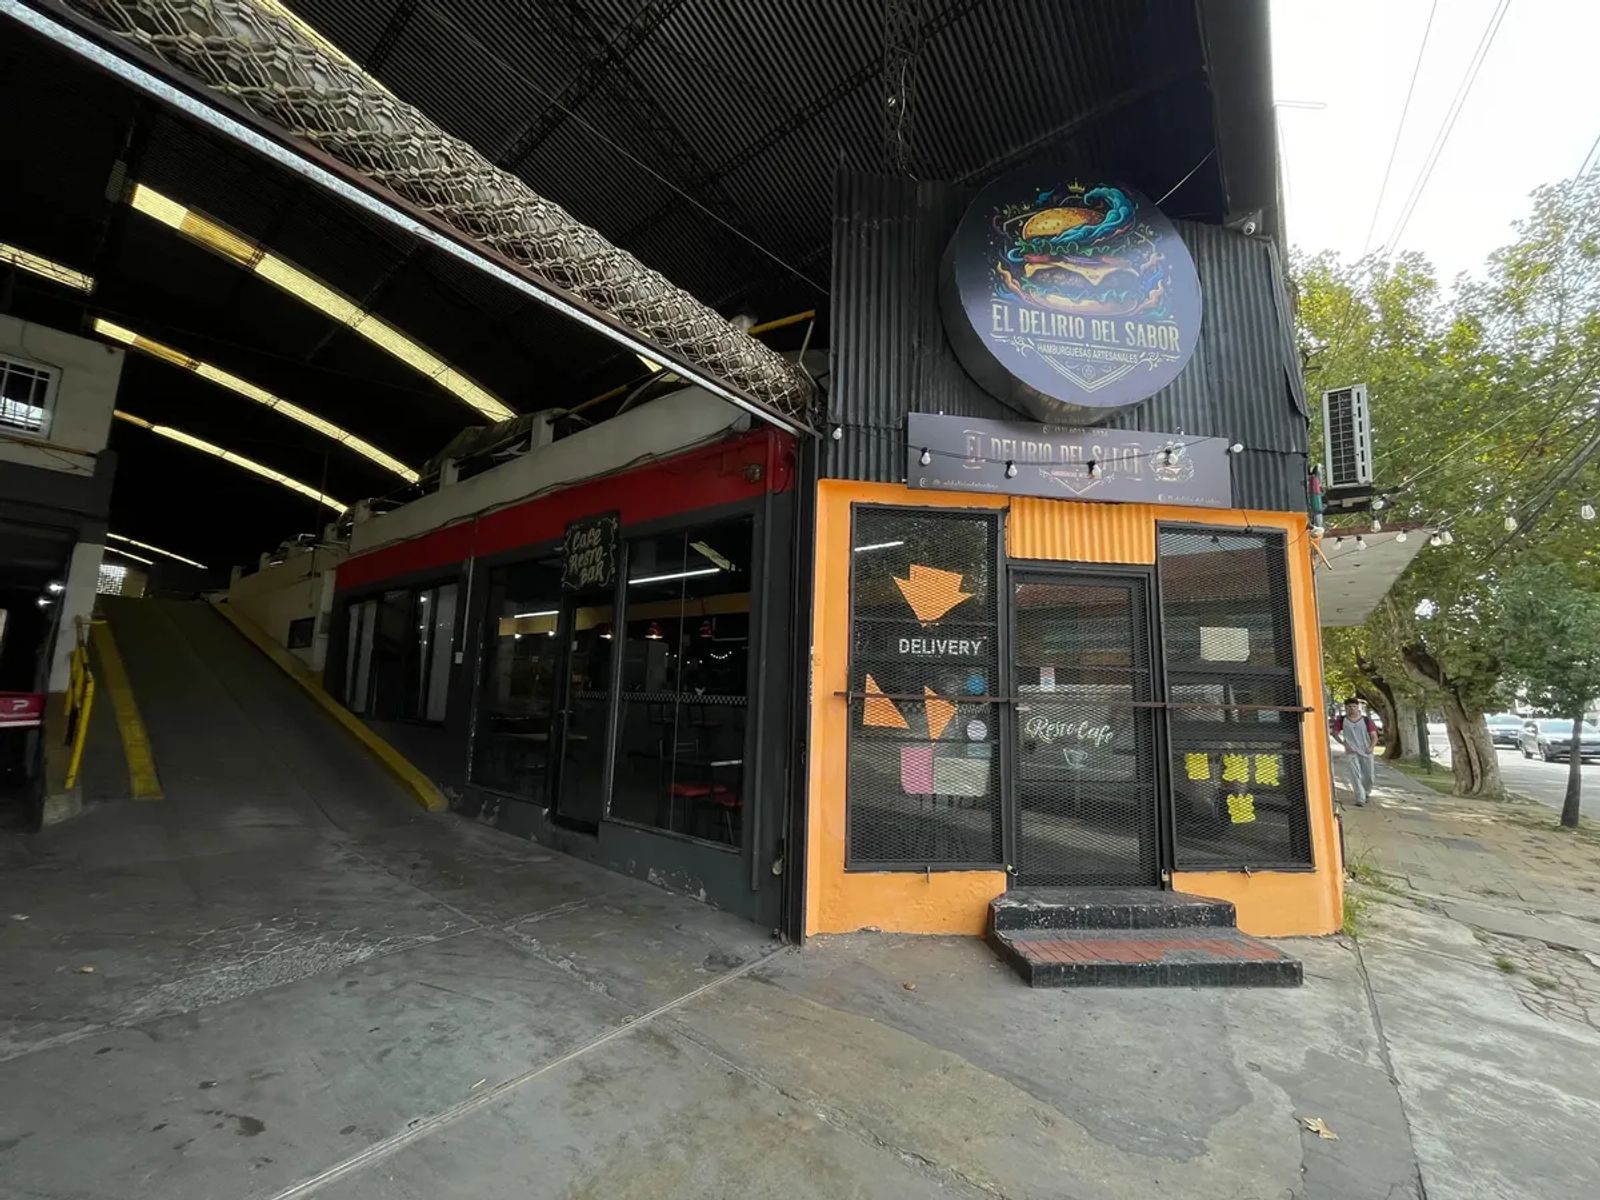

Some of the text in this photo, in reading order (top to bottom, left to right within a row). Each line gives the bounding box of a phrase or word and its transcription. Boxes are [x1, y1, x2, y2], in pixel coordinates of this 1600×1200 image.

[992, 303, 1181, 352] EL DELIRIO DEL SABOR
[1037, 343, 1139, 364] HAMBURGUESAS ARTESANALES
[966, 435, 986, 463] EL
[991, 437, 1053, 464] DELIRIO
[1060, 444, 1083, 465] DEL
[898, 638, 983, 656] DELIVERY
